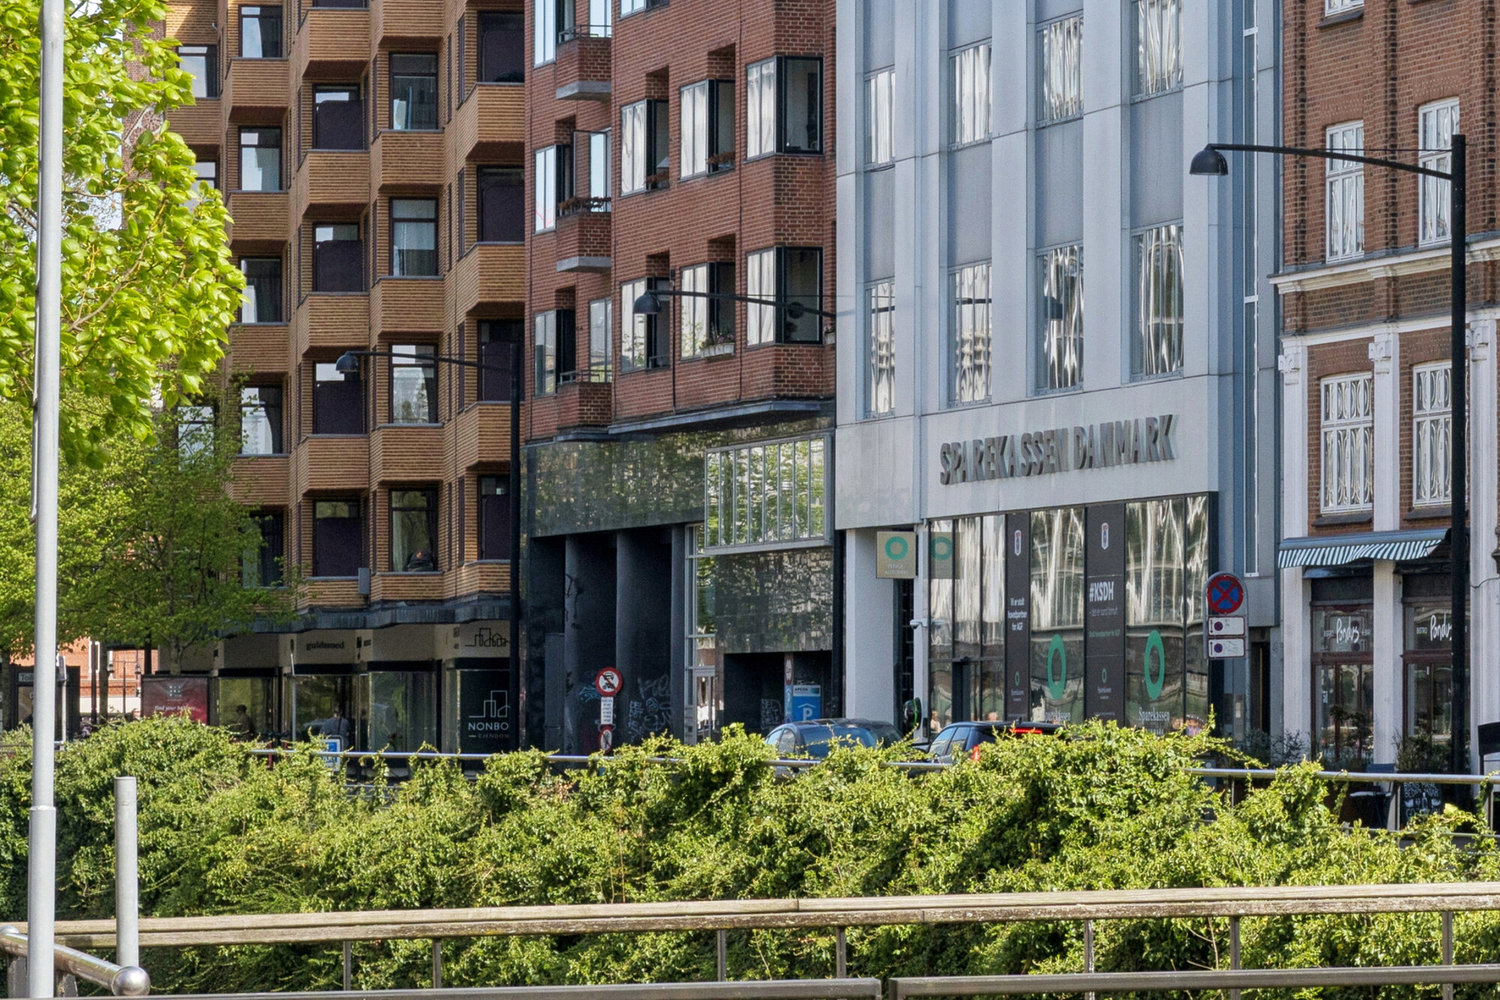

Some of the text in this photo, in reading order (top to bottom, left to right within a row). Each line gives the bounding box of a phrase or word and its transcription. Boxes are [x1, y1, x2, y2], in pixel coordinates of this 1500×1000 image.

[940, 414, 1176, 485] SPAREKASSEN DANMARK
[1089, 581, 1114, 602] #KSDH
[802, 707, 813, 721] P
[468, 721, 509, 731] NONBO
